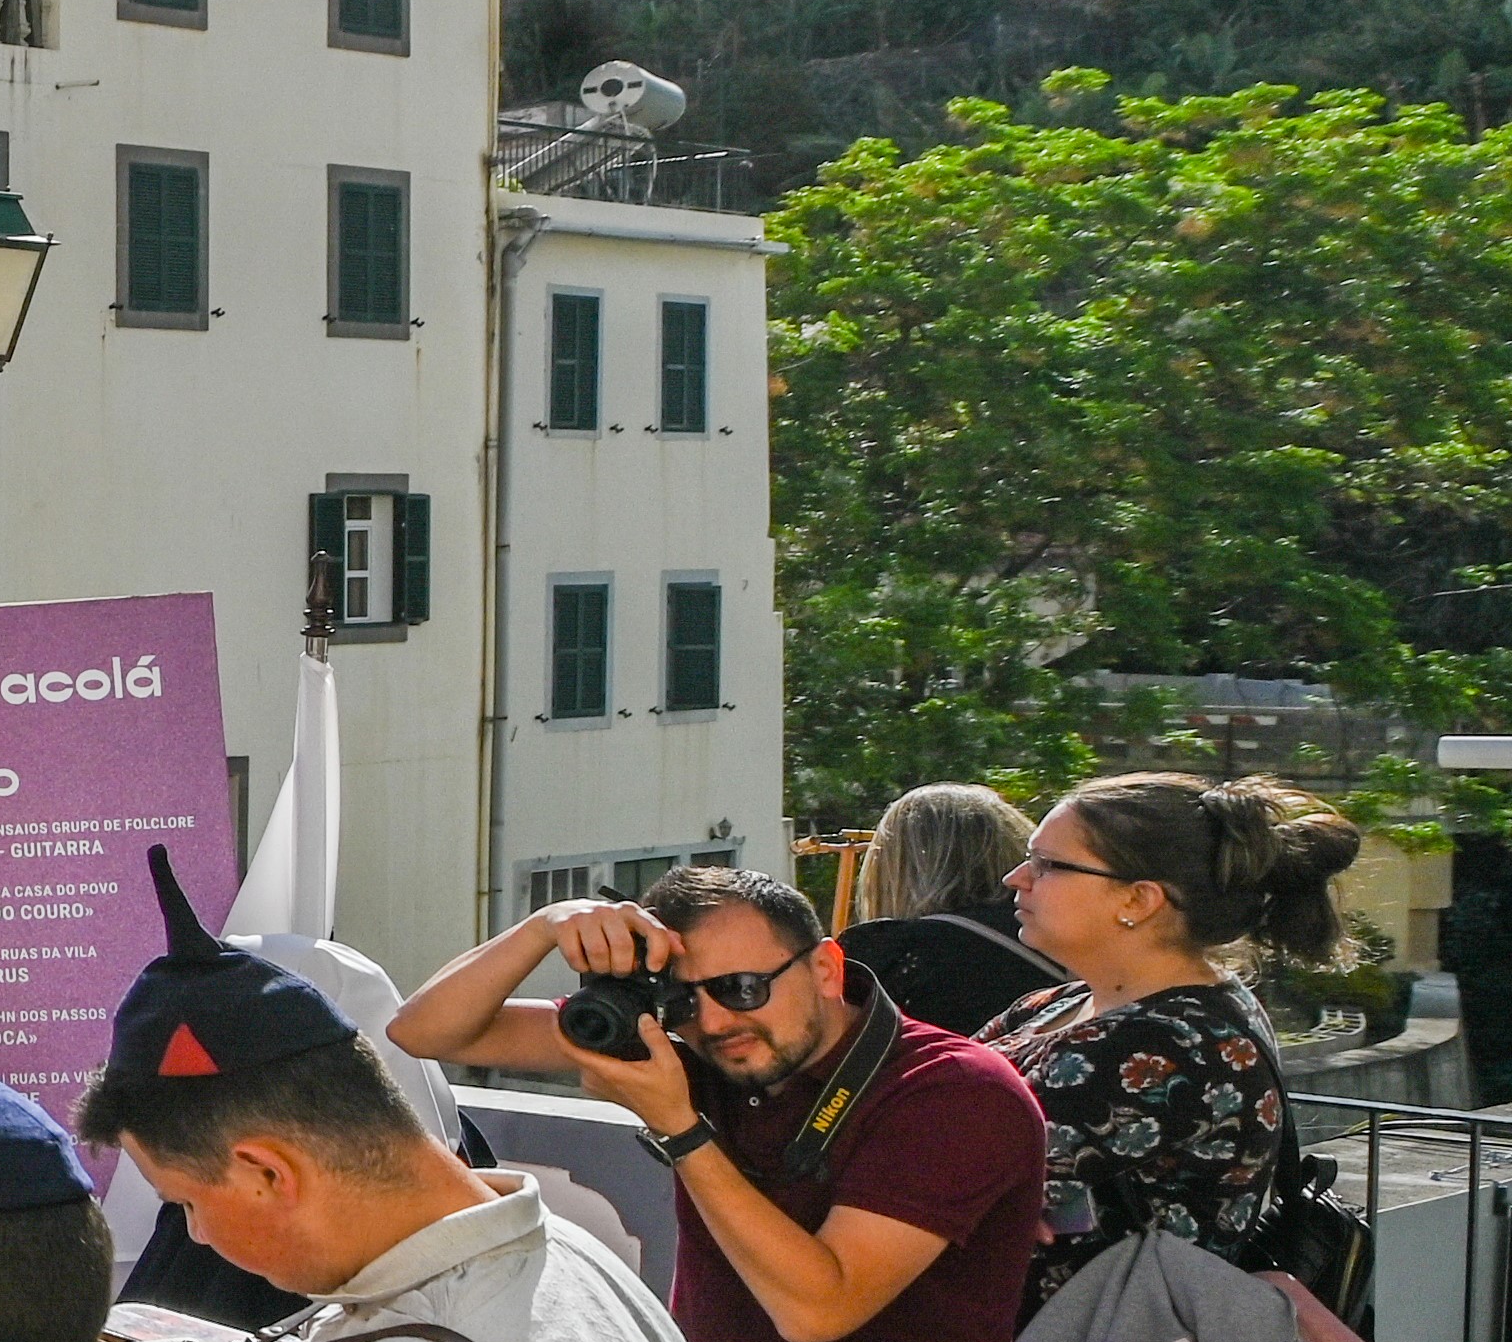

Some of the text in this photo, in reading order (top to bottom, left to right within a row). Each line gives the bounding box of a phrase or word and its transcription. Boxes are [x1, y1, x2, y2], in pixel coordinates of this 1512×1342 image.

[1, 655, 161, 704] acolá
[52, 821, 99, 833] GRUPO
[104, 819, 121, 831] DE
[125, 816, 194, 830] FOLCLORE
[11, 840, 103, 857] GUITARRA
[15, 885, 52, 897] CASA
[57, 884, 75, 895] DO
[80, 882, 117, 894] POVO
[21, 903, 93, 919] COURO»
[1, 948, 38, 960] RUAS
[42, 947, 61, 958] DA
[65, 946, 96, 957] VILA
[20, 1010, 47, 1022] DOS
[53, 1008, 106, 1021] PASSOS
[10, 1073, 46, 1084] RUAS
[52, 1072, 69, 1083] DA
[812, 1087, 850, 1133] Nikon
